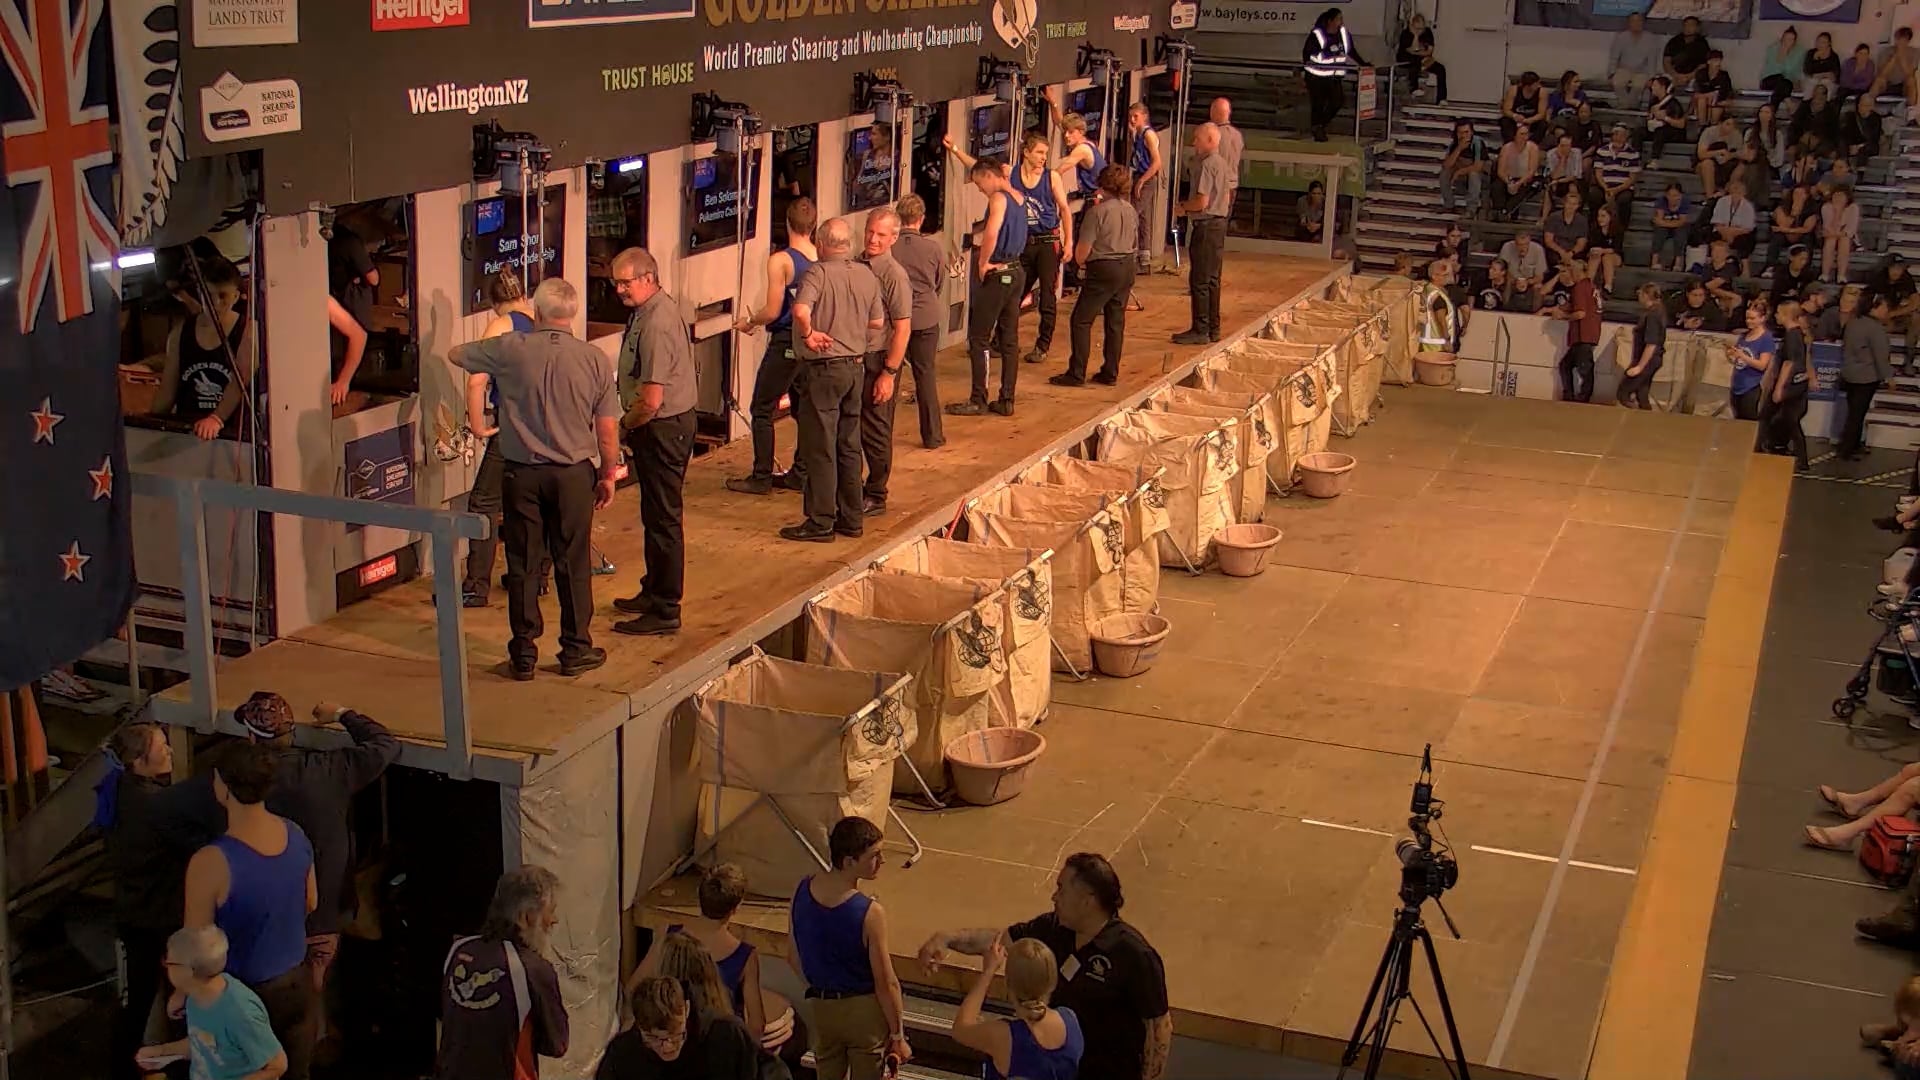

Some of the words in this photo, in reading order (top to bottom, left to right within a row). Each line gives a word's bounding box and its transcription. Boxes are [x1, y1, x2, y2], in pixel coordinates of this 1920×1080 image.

[208, 10, 247, 25] LANDS
[249, 10, 285, 25] TRUST
[1045, 23, 1066, 39] TRUST
[703, 43, 739, 72] World
[744, 40, 788, 67] Premier
[791, 35, 839, 61] Shearing
[841, 32, 859, 55] and
[862, 27, 922, 52] Woolhandling
[925, 20, 982, 48] Championship
[602, 66, 647, 91] TRUST
[652, 62, 694, 86] HOUSE
[261, 89, 295, 101] NATIONAL
[408, 79, 529, 115] WellingtonNZ
[262, 113, 289, 125] CIRCUIT
[498, 238, 518, 253] Sam
[691, 235, 697, 249] 2
[475, 289, 481, 304] 1
